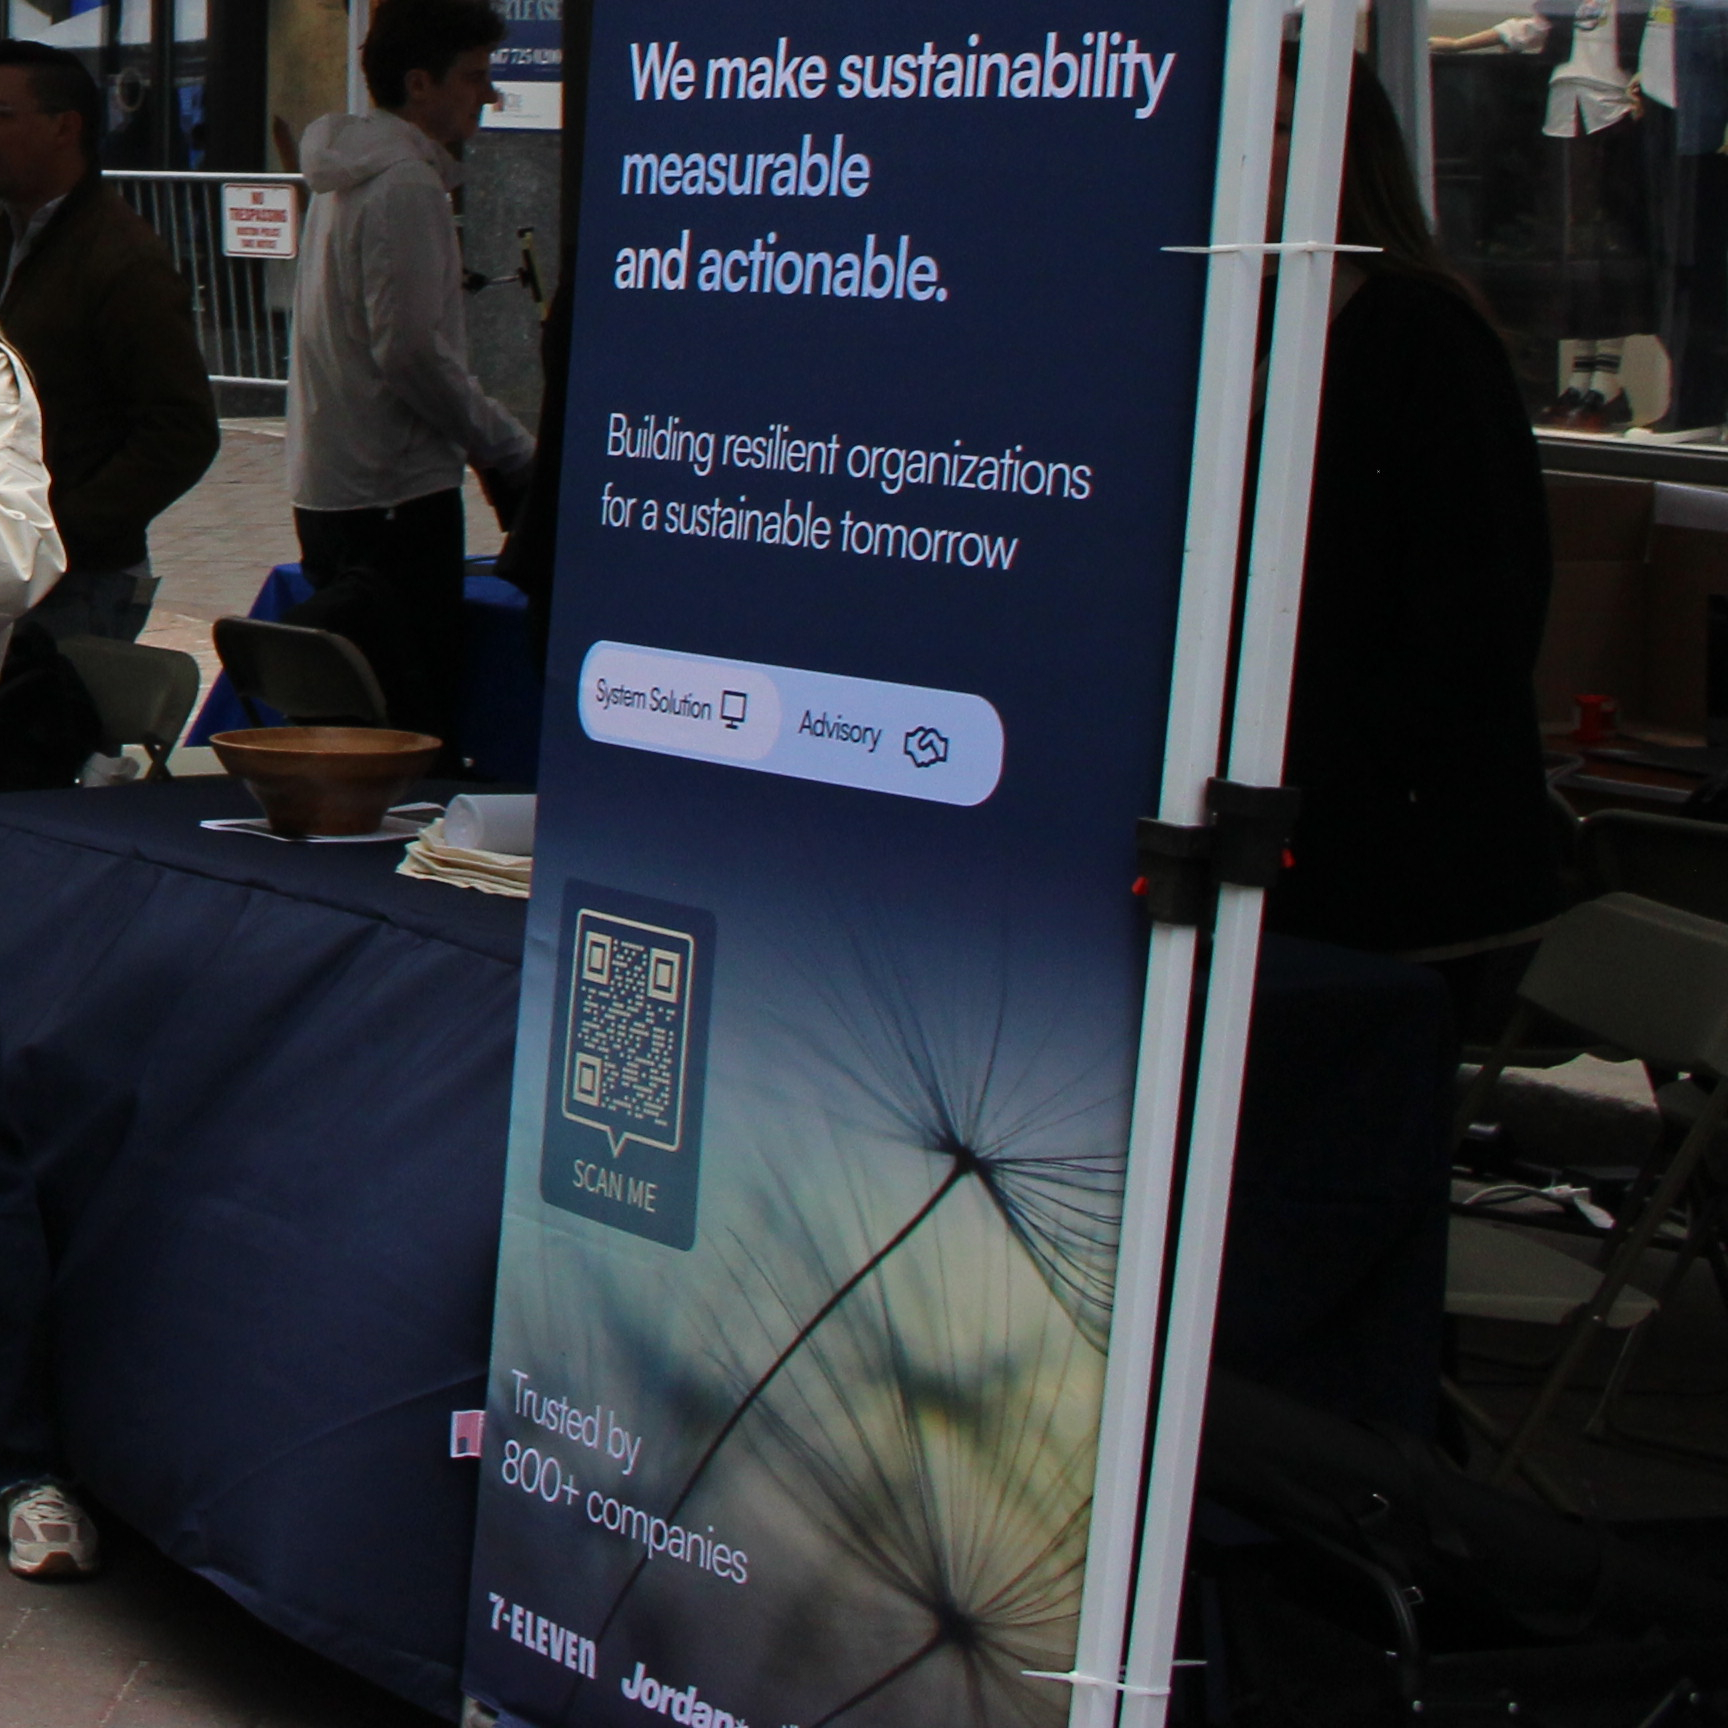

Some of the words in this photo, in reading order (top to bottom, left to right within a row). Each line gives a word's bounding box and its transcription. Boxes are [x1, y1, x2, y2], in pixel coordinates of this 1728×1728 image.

[630, 41, 695, 102] We
[705, 36, 827, 100] make
[838, 31, 1176, 120] sustainability
[621, 133, 870, 197] measurable
[614, 229, 689, 291] and
[698, 231, 948, 301] actionable.
[606, 412, 715, 477] Building
[722, 422, 840, 477] resilient
[847, 439, 1092, 500] organizations
[601, 482, 637, 528] for
[642, 498, 659, 531] a
[664, 496, 832, 552] sustainable
[841, 511, 1018, 571] tomorrow
[595, 678, 645, 711] System
[649, 687, 712, 721] Solution
[798, 710, 883, 753] Advisory
[572, 1158, 623, 1202] SCAN
[627, 1176, 658, 1213] ME
[512, 1368, 602, 1449] Trusted
[607, 1410, 642, 1476] by
[501, 1439, 580, 1506] 800+
[586, 1490, 749, 1584] companies
